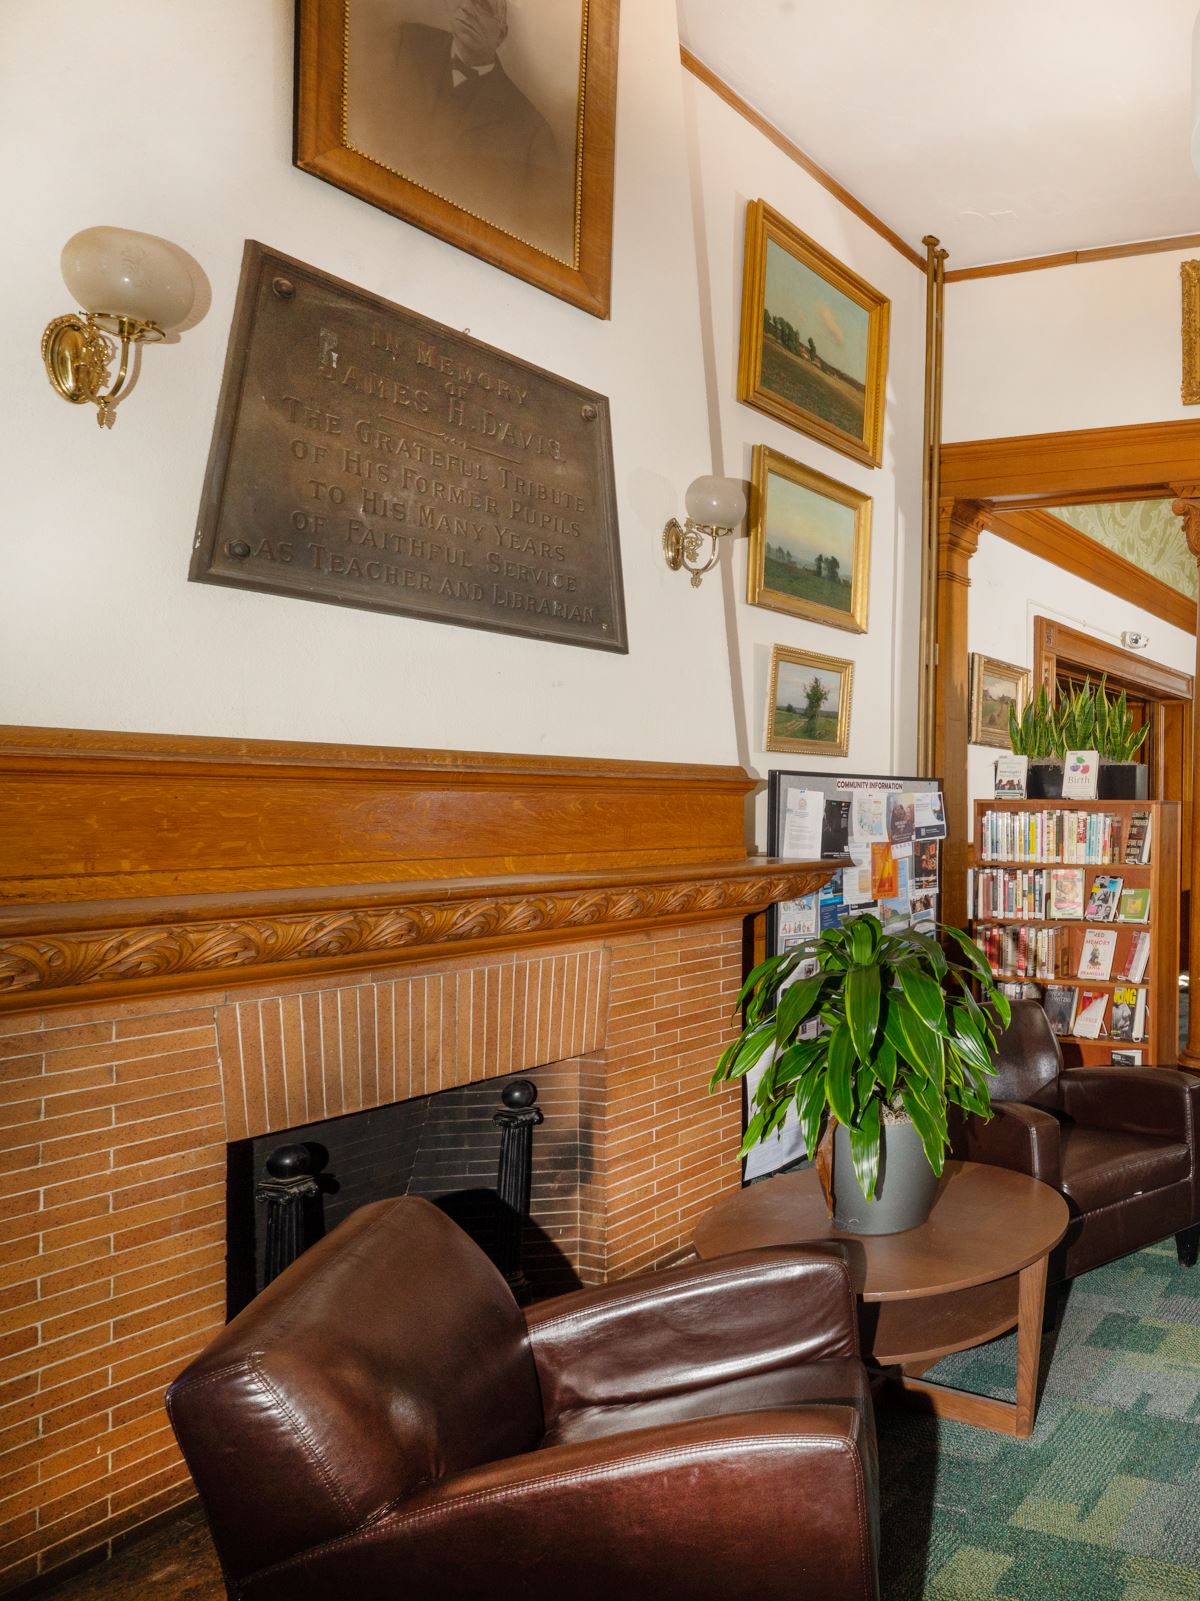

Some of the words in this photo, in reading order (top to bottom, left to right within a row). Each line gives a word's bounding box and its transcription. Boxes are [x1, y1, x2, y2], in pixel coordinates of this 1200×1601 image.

[319, 364, 431, 413] JAMES
[416, 341, 528, 406] MEMORY
[445, 382, 467, 399] OF
[282, 396, 341, 436] THE
[354, 419, 488, 481] GRATEFUL
[499, 467, 585, 513] TRIBUTE
[290, 439, 329, 464] OF
[342, 449, 389, 483] HIS
[403, 467, 498, 515] FORMER
[510, 500, 581, 538] PUPILS
[290, 510, 329, 534] OF
[345, 518, 473, 569] FAITHFUL
[486, 553, 577, 593] SERVICE
[308, 479, 346, 505] TO
[361, 487, 406, 521] HIS
[419, 505, 486, 541] MANY
[495, 525, 566, 562] YEARS
[253, 538, 294, 563] AS
[308, 543, 433, 591] TEACHER
[440, 577, 484, 602] AND
[492, 584, 594, 624] LIBRARIAN
[836, 780, 868, 789] COMMUNITY
[870, 781, 903, 790] INFORMATION
